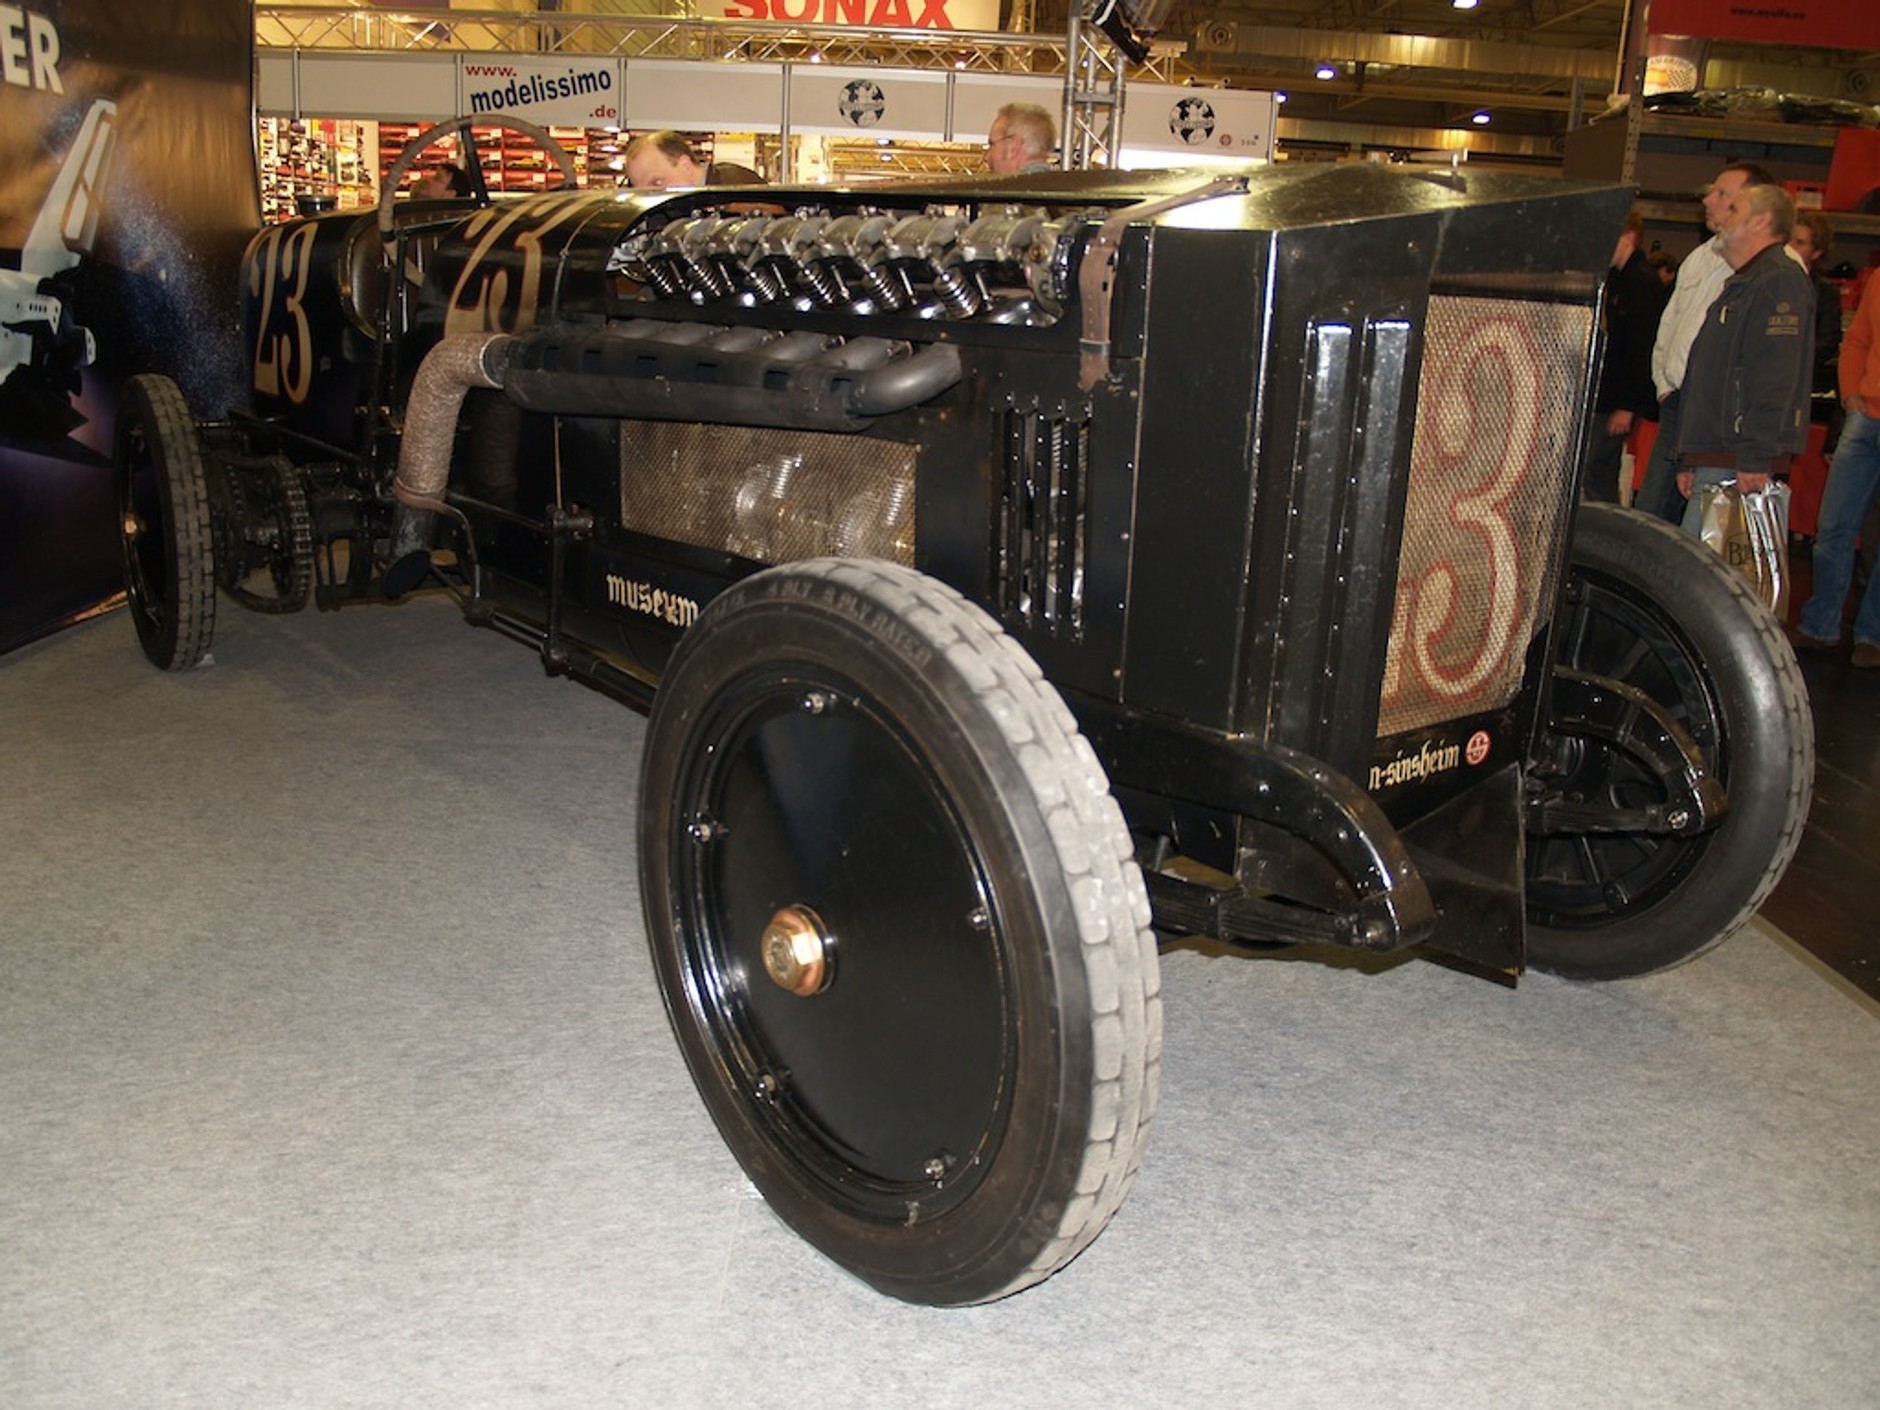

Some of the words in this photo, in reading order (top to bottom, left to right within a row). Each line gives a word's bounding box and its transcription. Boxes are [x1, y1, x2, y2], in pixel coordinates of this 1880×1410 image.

[0, 5, 64, 95] ER
[465, 65, 517, 77] www.
[470, 68, 611, 113] modelissimo
[589, 105, 616, 118] .de
[241, 219, 319, 406] 23
[606, 574, 699, 627] museum
